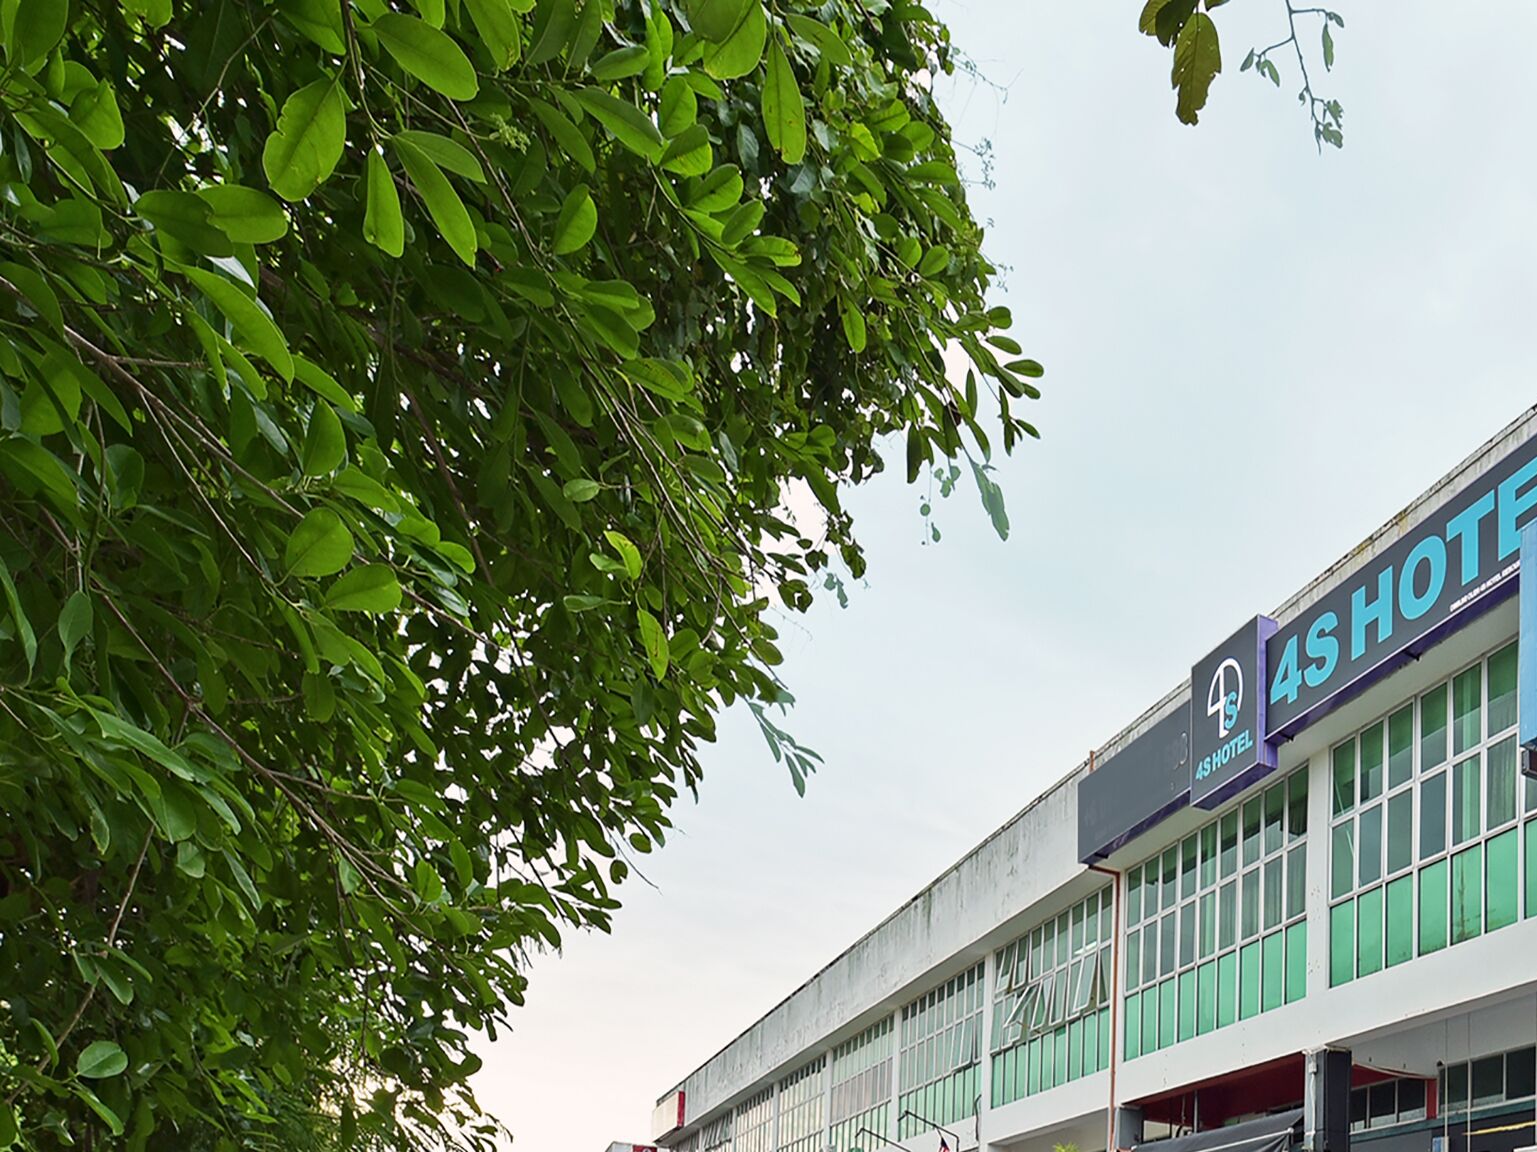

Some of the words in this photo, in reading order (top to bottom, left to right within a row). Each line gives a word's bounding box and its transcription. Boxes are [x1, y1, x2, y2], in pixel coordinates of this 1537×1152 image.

[1270, 610, 1340, 706] 4S
[1195, 756, 1211, 781] 4S
[1212, 729, 1253, 774] HOTEL
